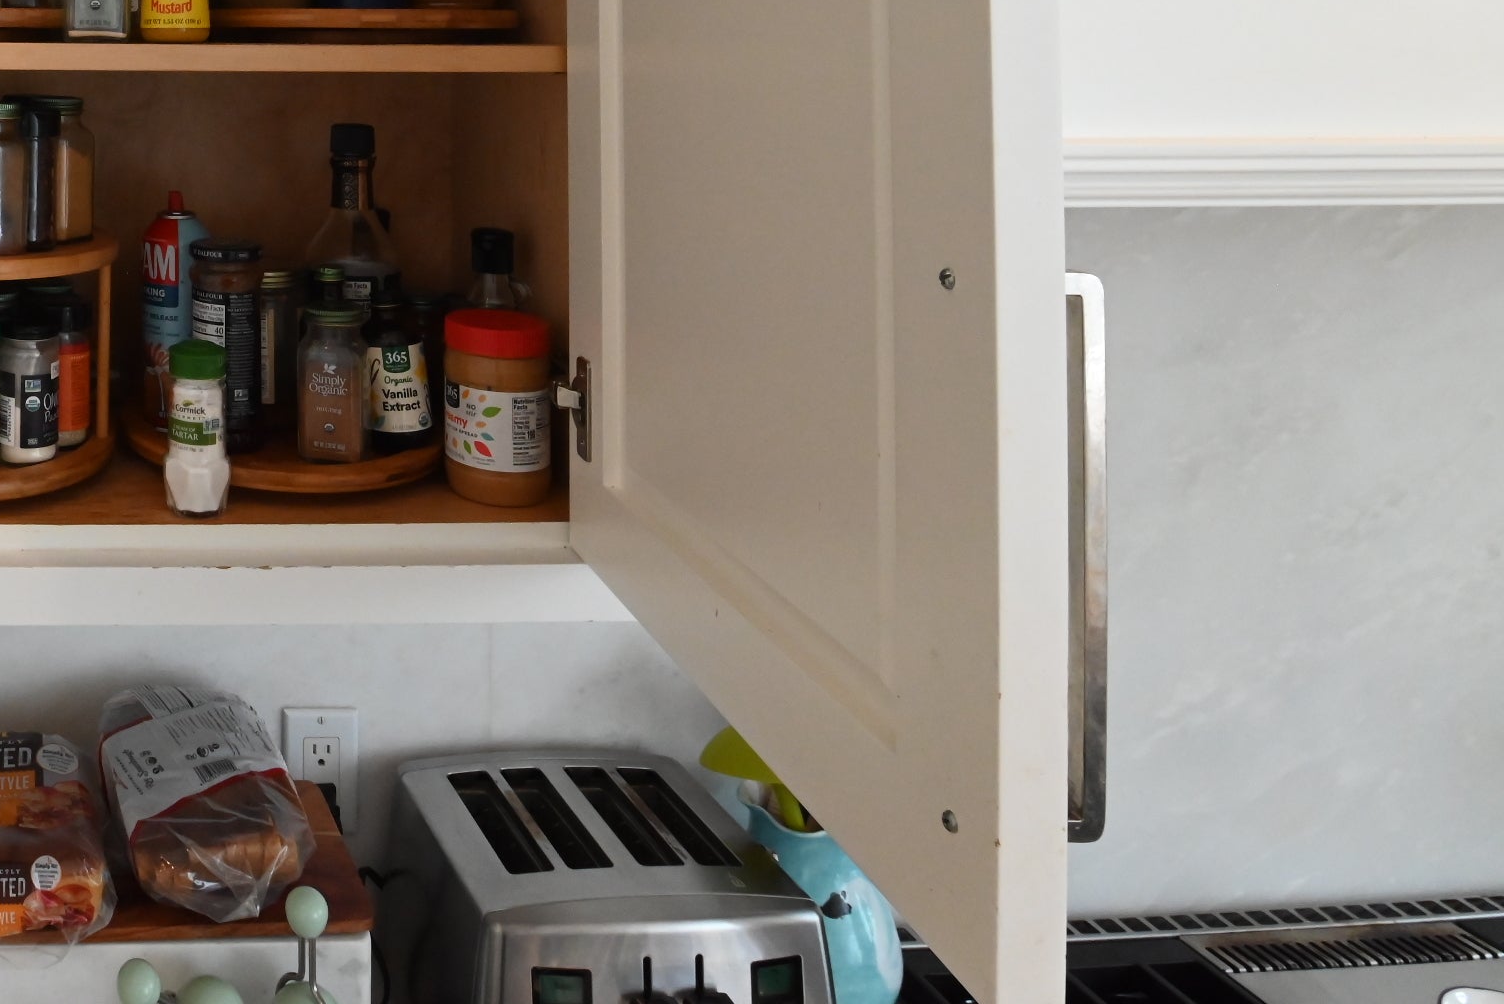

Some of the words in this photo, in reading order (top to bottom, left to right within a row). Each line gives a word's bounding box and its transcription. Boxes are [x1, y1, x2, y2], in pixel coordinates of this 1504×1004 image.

[143, 242, 176, 281] AM
[385, 351, 408, 364] 365
[312, 372, 347, 386] Simply
[384, 375, 413, 386] Organic
[308, 383, 347, 396] Organic
[382, 388, 418, 399] Vanilla
[382, 400, 421, 412] Extract
[172, 428, 199, 441] TARTAR
